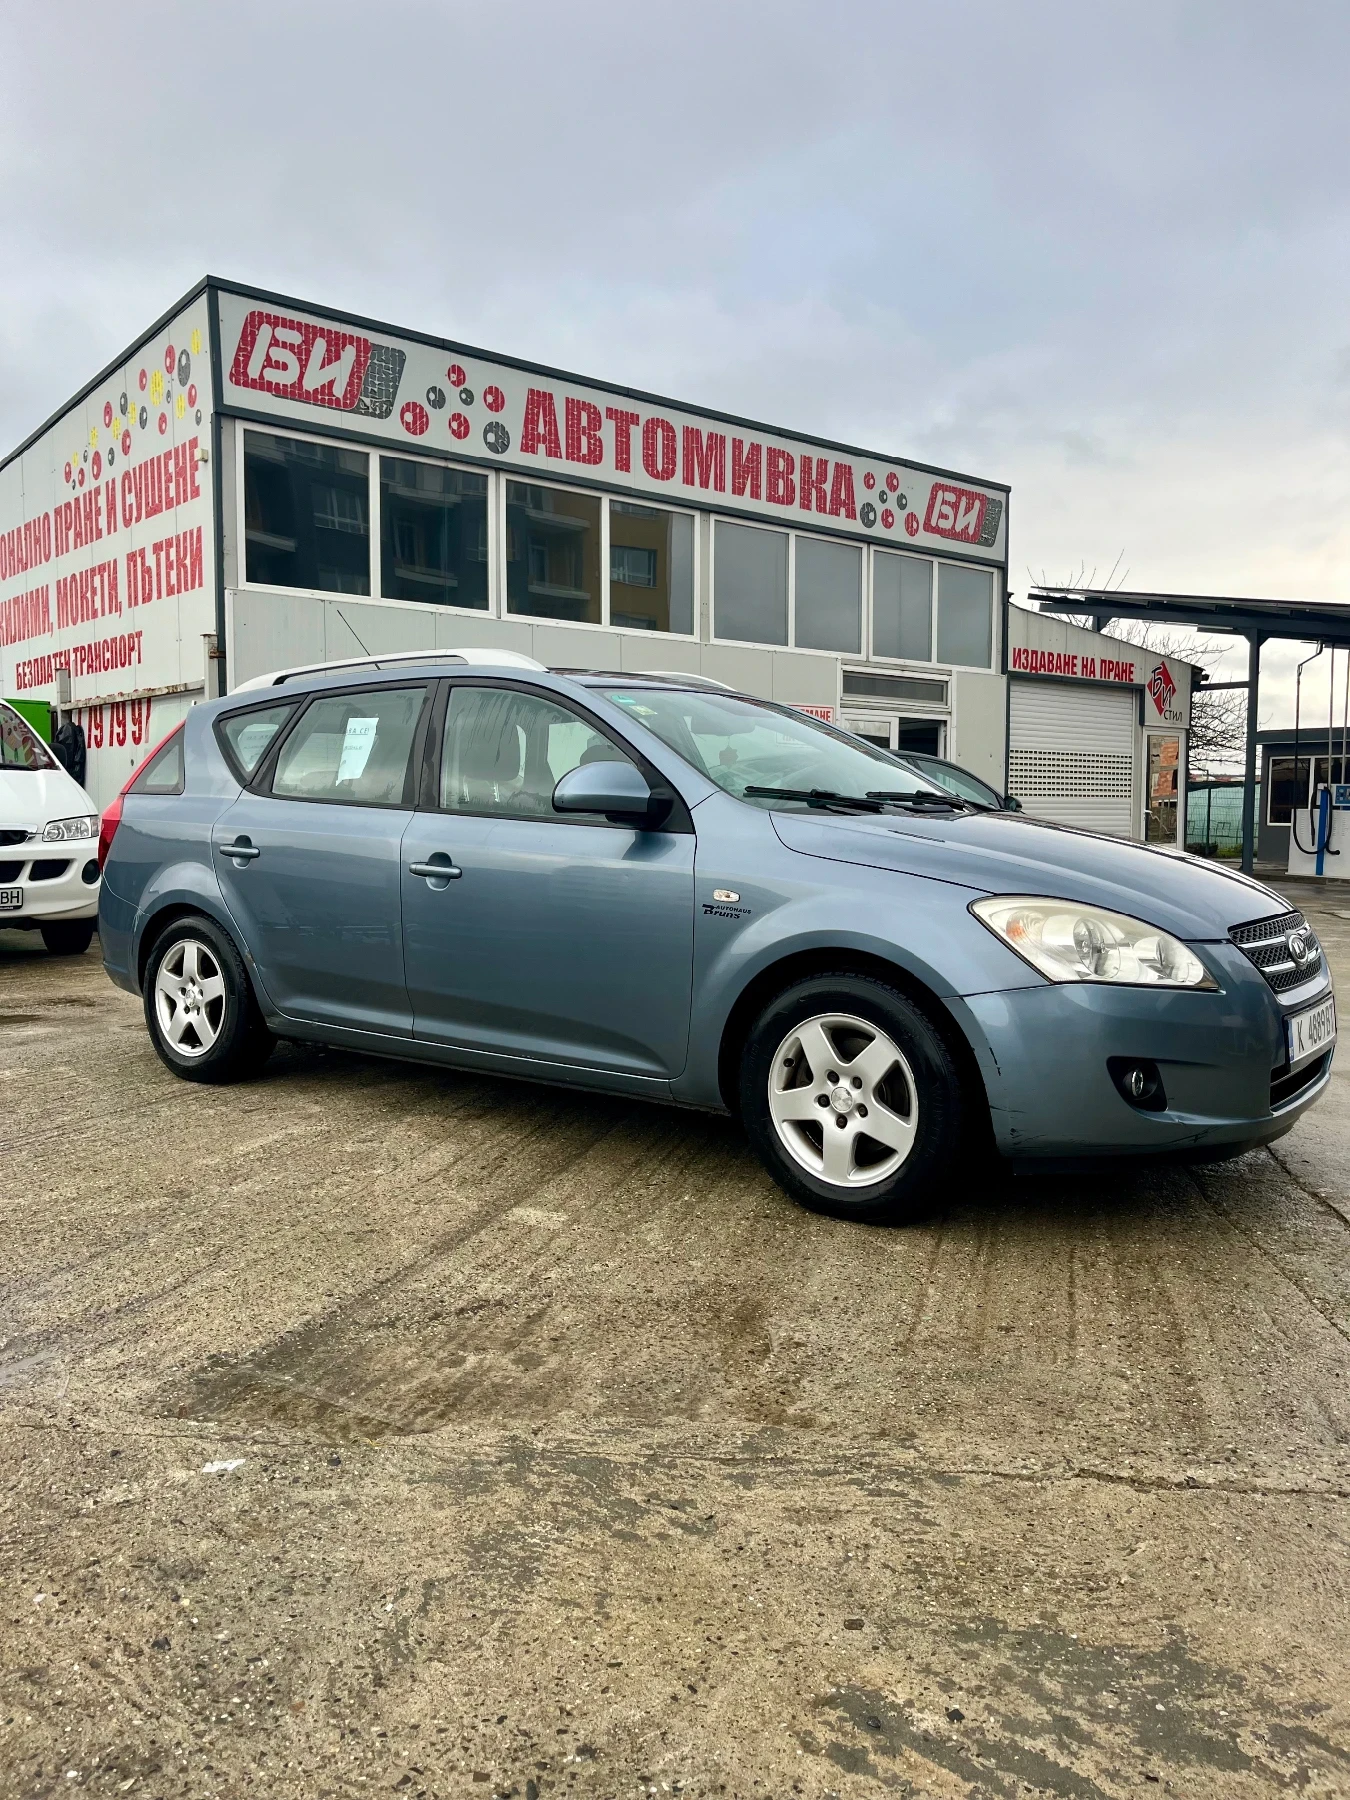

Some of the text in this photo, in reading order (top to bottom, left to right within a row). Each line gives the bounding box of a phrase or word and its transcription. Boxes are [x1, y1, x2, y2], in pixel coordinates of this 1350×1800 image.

[520, 387, 858, 521] АВТОМИВКА
[54, 485, 103, 558] ПРАНЕ
[105, 477, 118, 536] И
[120, 436, 201, 529] СУШЕНЕ
[56, 558, 122, 630] МОКЕТИ,
[126, 526, 204, 609] ПЪТЕКИ
[73, 630, 143, 677] ТРАНСПОРТ
[1012, 647, 1135, 682] ИЗДАВАНЕ НА ПРАНЕ
[1163, 709, 1183, 722] СТИЛ
[702, 903, 741, 919] Bruns
[715, 904, 752, 914] AUTOHAUS
[1297, 1019, 1305, 1053] K
